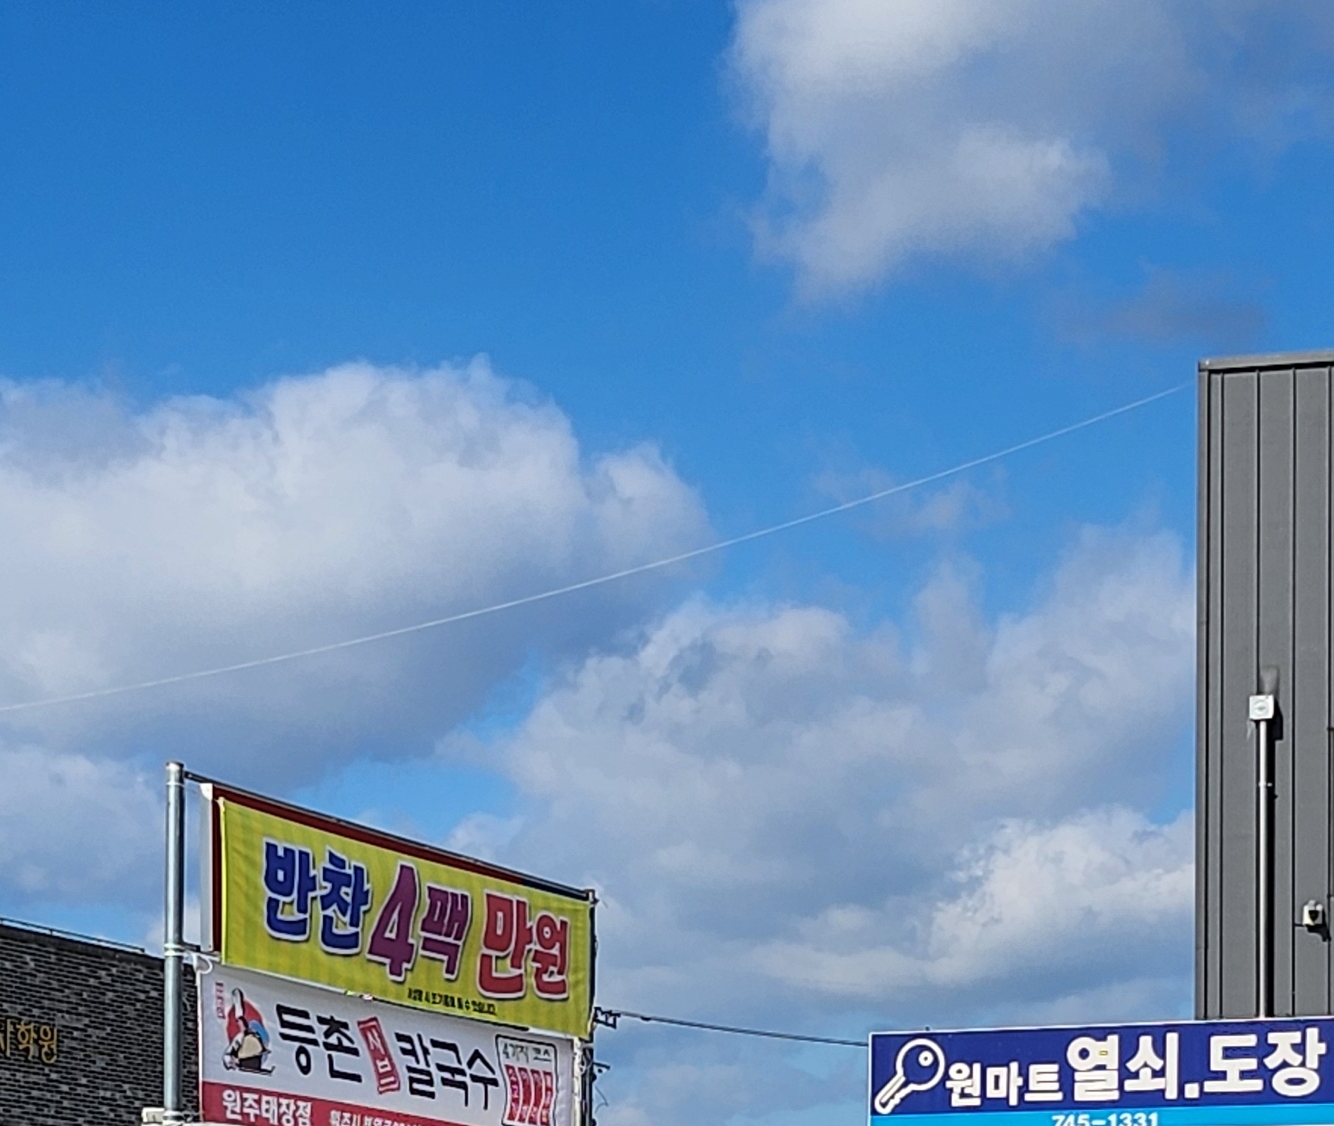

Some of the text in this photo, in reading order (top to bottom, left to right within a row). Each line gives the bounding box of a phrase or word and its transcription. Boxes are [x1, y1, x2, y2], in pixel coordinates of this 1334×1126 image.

[263, 838, 571, 1000] 반찬 4팩 만원
[275, 1003, 364, 1084] 등촌
[393, 1031, 500, 1111] 칼국수
[945, 1061, 1064, 1108] 원마트
